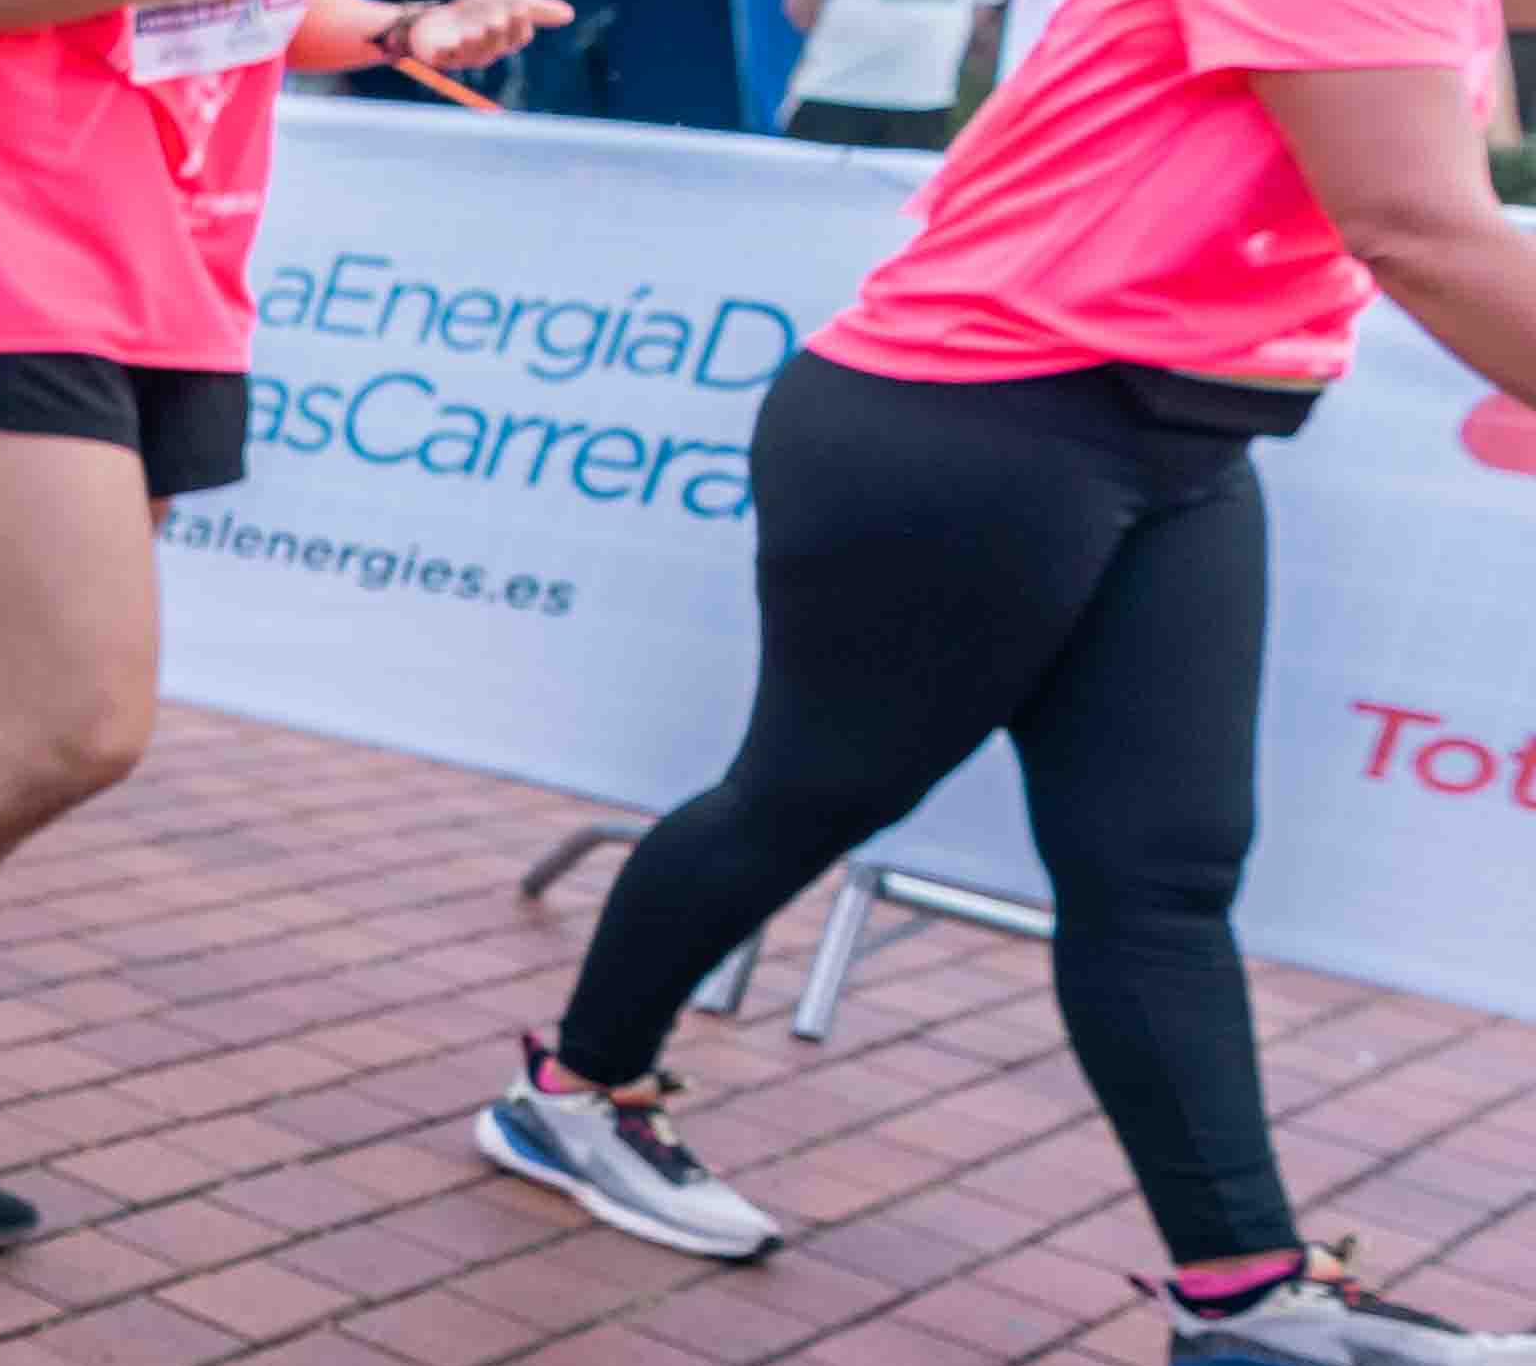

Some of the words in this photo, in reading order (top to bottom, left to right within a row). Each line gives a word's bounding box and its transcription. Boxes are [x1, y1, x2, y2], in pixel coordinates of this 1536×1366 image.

[256, 251, 793, 395] aEnergíaD
[245, 371, 751, 520] asCarrera
[160, 503, 577, 618] talenergies.es
[1349, 699, 1536, 813] Tot
